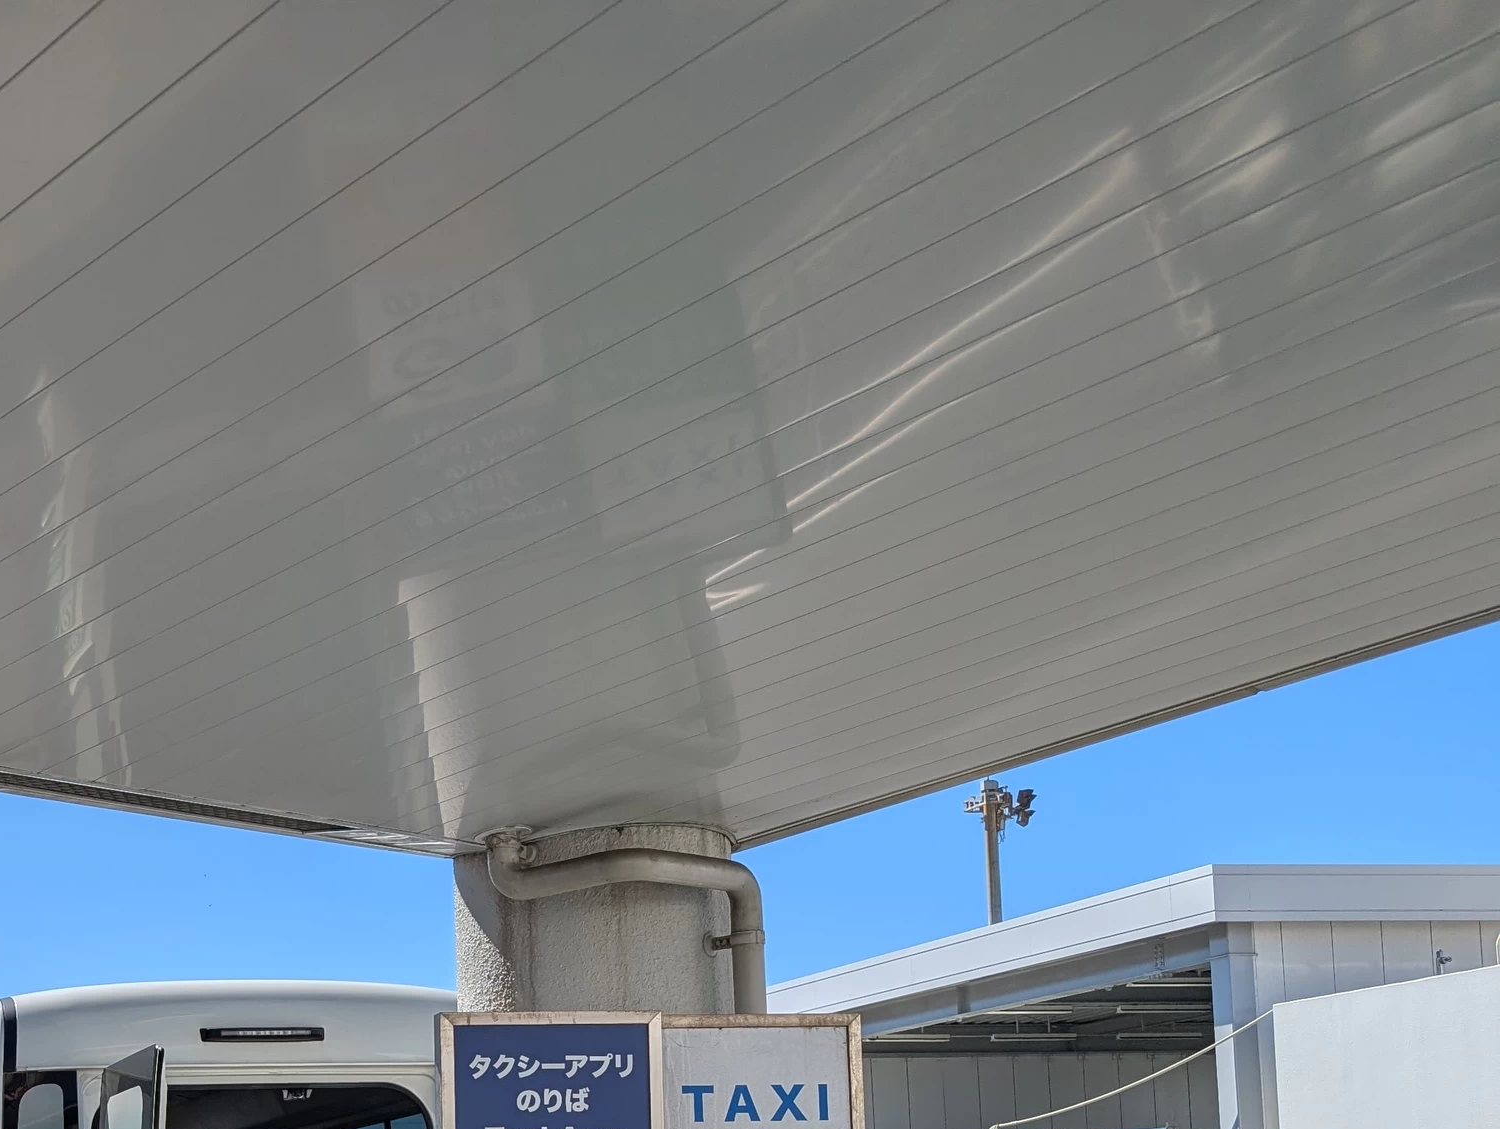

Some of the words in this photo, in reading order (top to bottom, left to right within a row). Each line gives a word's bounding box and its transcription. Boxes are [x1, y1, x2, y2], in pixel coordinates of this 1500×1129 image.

[469, 1053, 635, 1078] タクシーアプリ
[516, 1087, 589, 1113] のりば
[682, 1083, 829, 1123] TAXI
